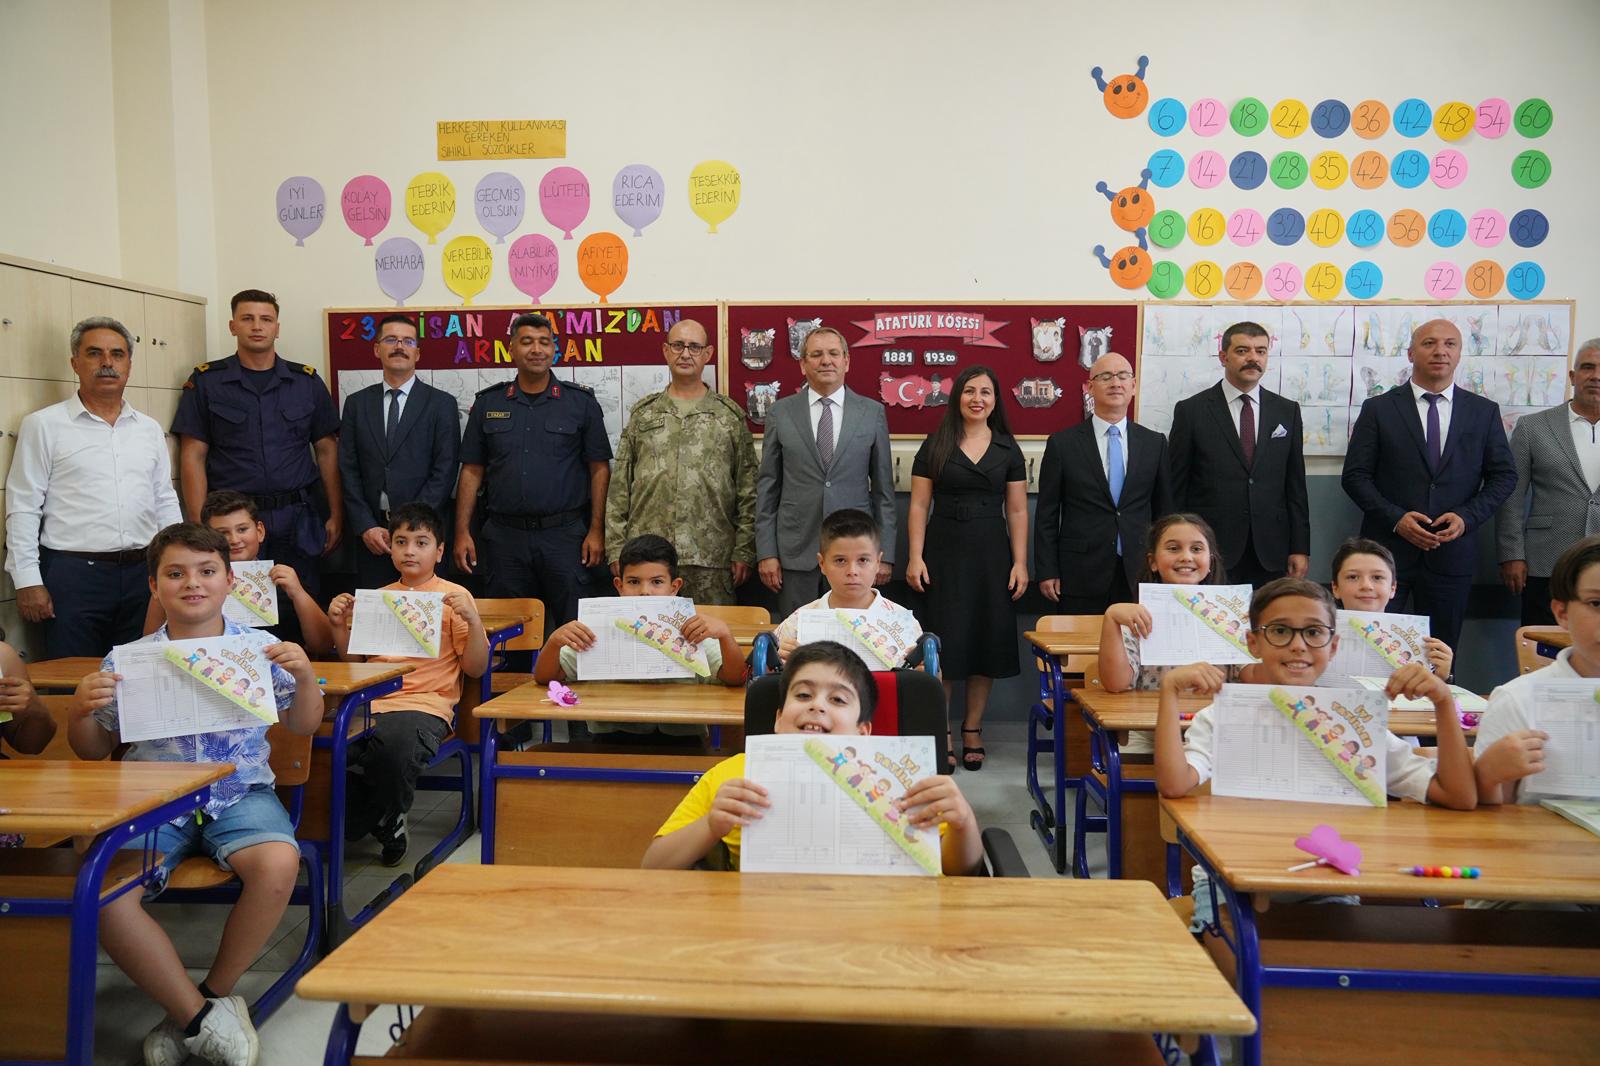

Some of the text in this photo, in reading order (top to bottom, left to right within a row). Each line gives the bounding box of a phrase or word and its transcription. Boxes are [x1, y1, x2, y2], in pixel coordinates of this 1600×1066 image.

[1158, 102, 1551, 134] 6 12 18 24 30 36 42 48 54 60
[464, 132, 510, 144] GEREKEN
[1156, 153, 1547, 183] 7 14 21 28 35 42 49 56 70
[344, 190, 378, 204] KOLAY
[482, 204, 518, 218] OLSUN
[1158, 212, 1547, 242] 8 16 24 32 40 48 56 64 72 80
[375, 254, 425, 271] MERHABA
[585, 262, 624, 277] OLSUN
[1155, 263, 1539, 295] 9 18 27 36 45 54 72 81 90
[340, 315, 377, 341] 23
[876, 312, 980, 332] ATATÜRK KÖŞESİ
[883, 351, 913, 364] 1881
